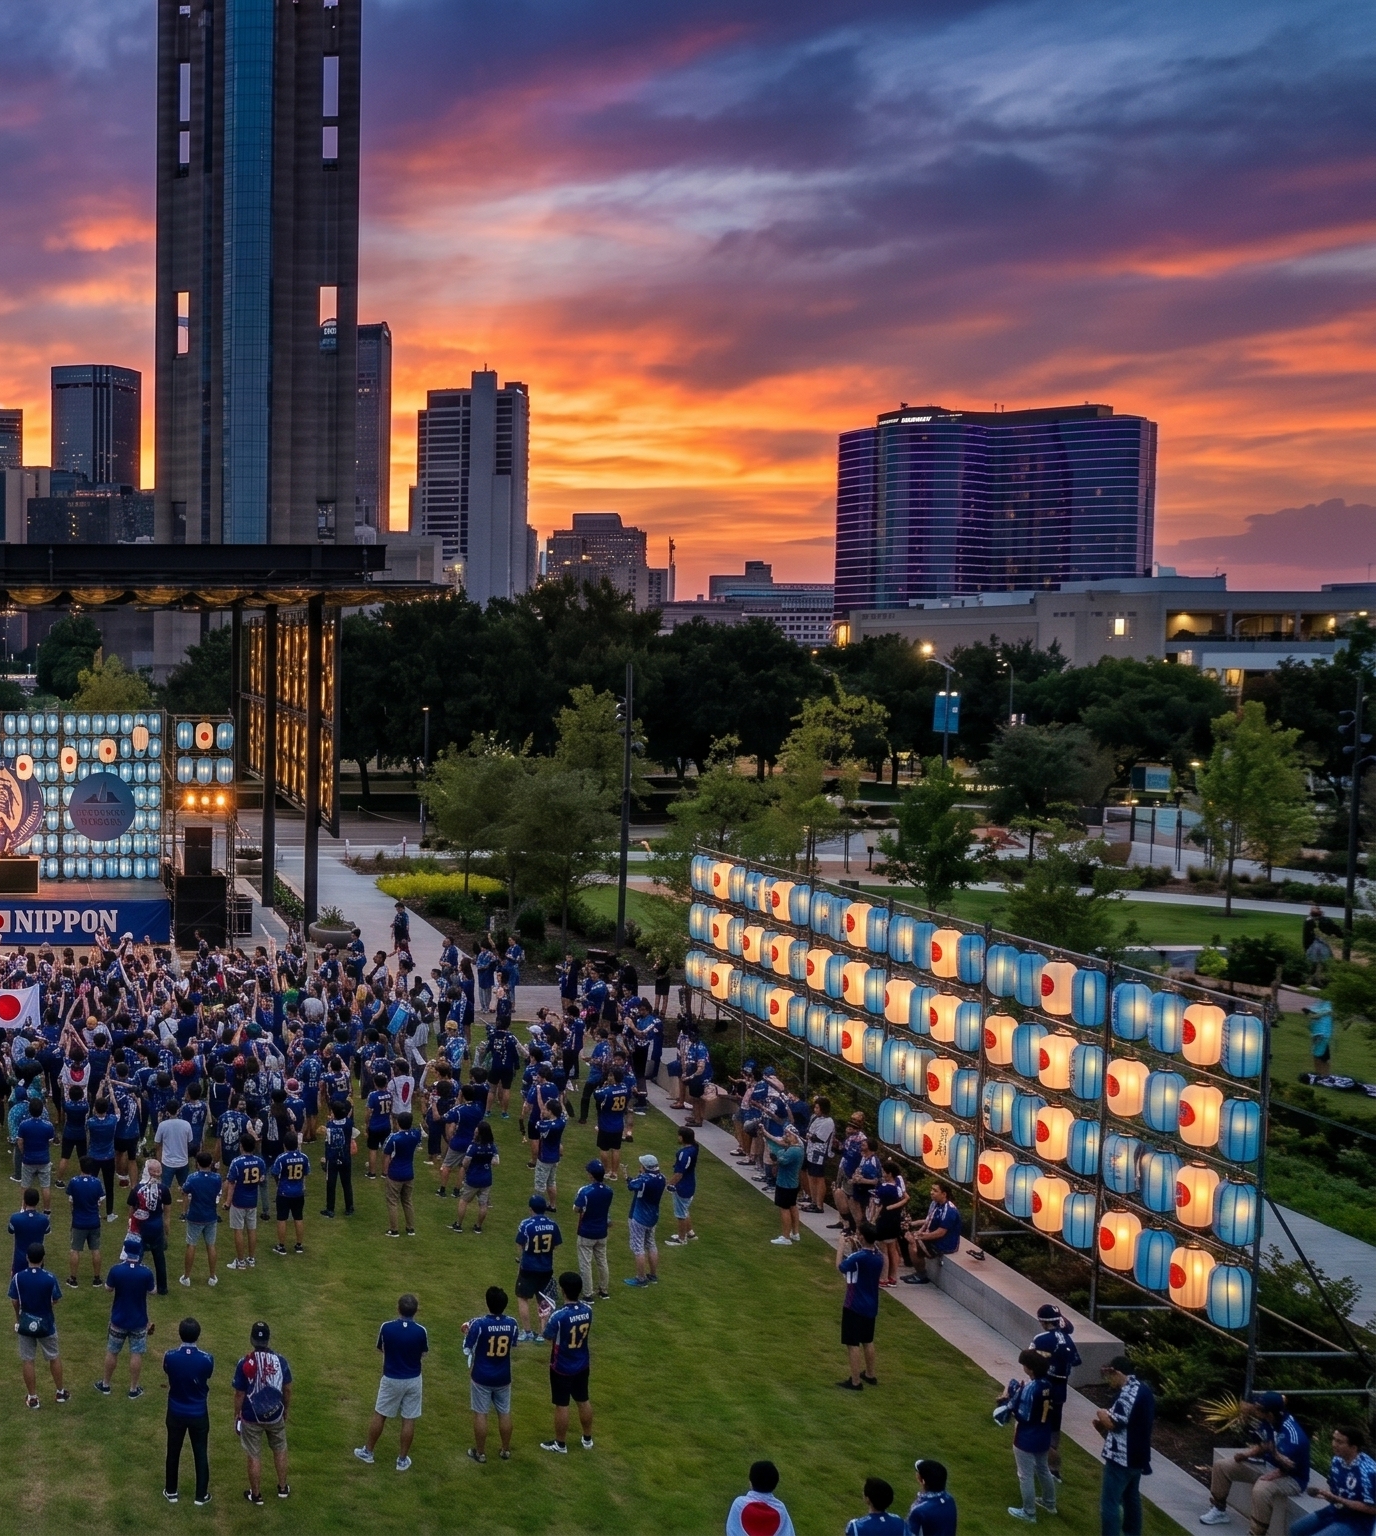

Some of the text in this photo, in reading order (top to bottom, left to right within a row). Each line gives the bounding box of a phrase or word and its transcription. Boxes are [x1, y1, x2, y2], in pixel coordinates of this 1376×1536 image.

[14, 909, 118, 933] NIPPON
[533, 1234, 553, 1254] 13
[486, 1335, 510, 1357] 18
[568, 1323, 590, 1349] 17
